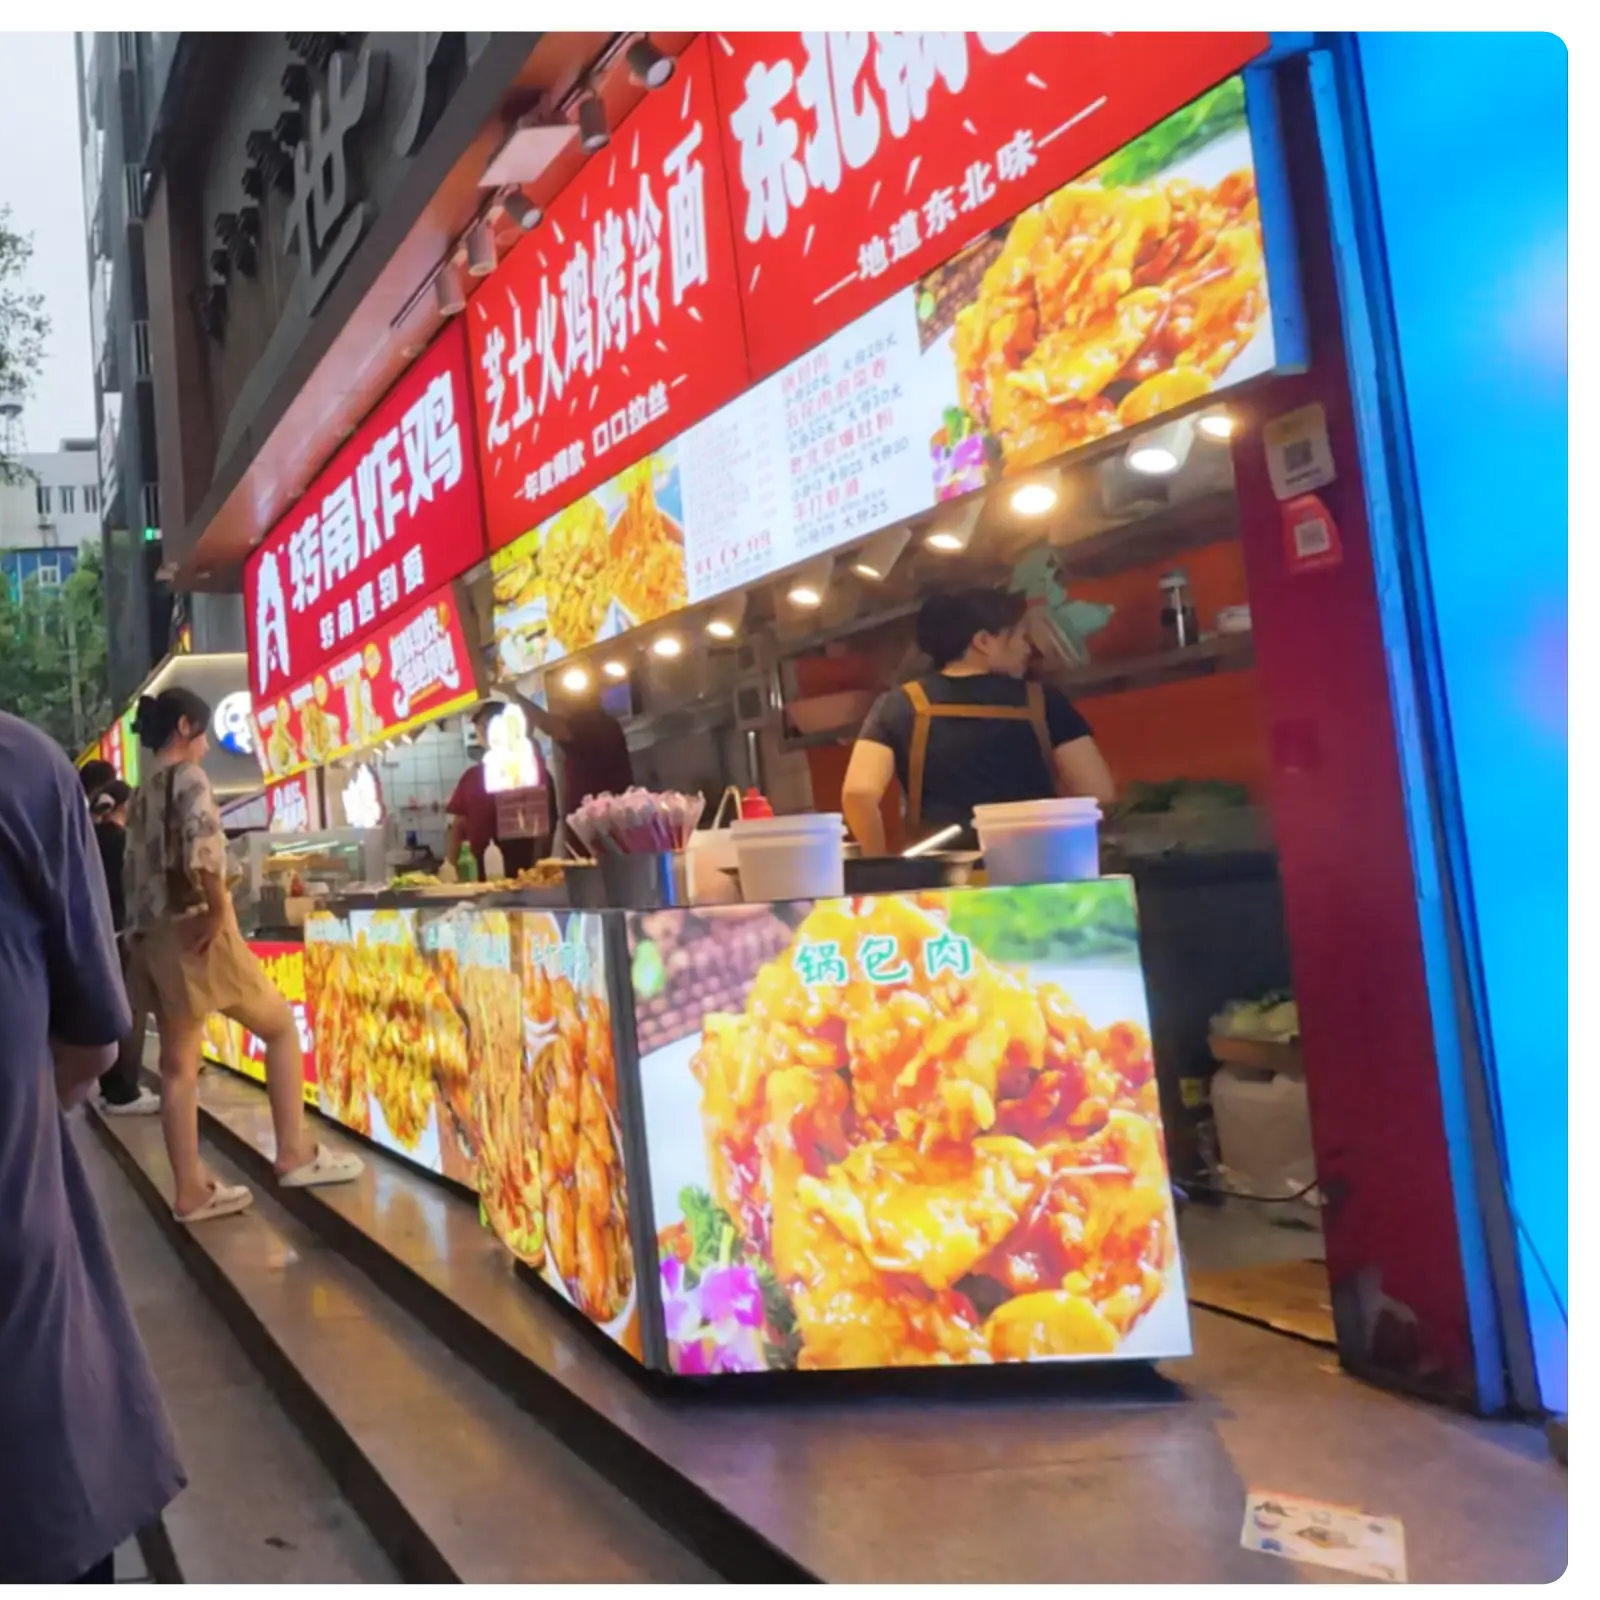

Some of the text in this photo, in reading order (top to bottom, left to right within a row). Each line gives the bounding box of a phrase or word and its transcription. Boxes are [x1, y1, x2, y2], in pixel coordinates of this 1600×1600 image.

[858, 130, 1038, 281] 地道东北味
[481, 120, 707, 448] 芝士火鸡烤冷面
[288, 369, 463, 613] 转角炸鸡
[592, 381, 670, 456] 口口拉丝
[794, 932, 973, 986] 锅包肉
